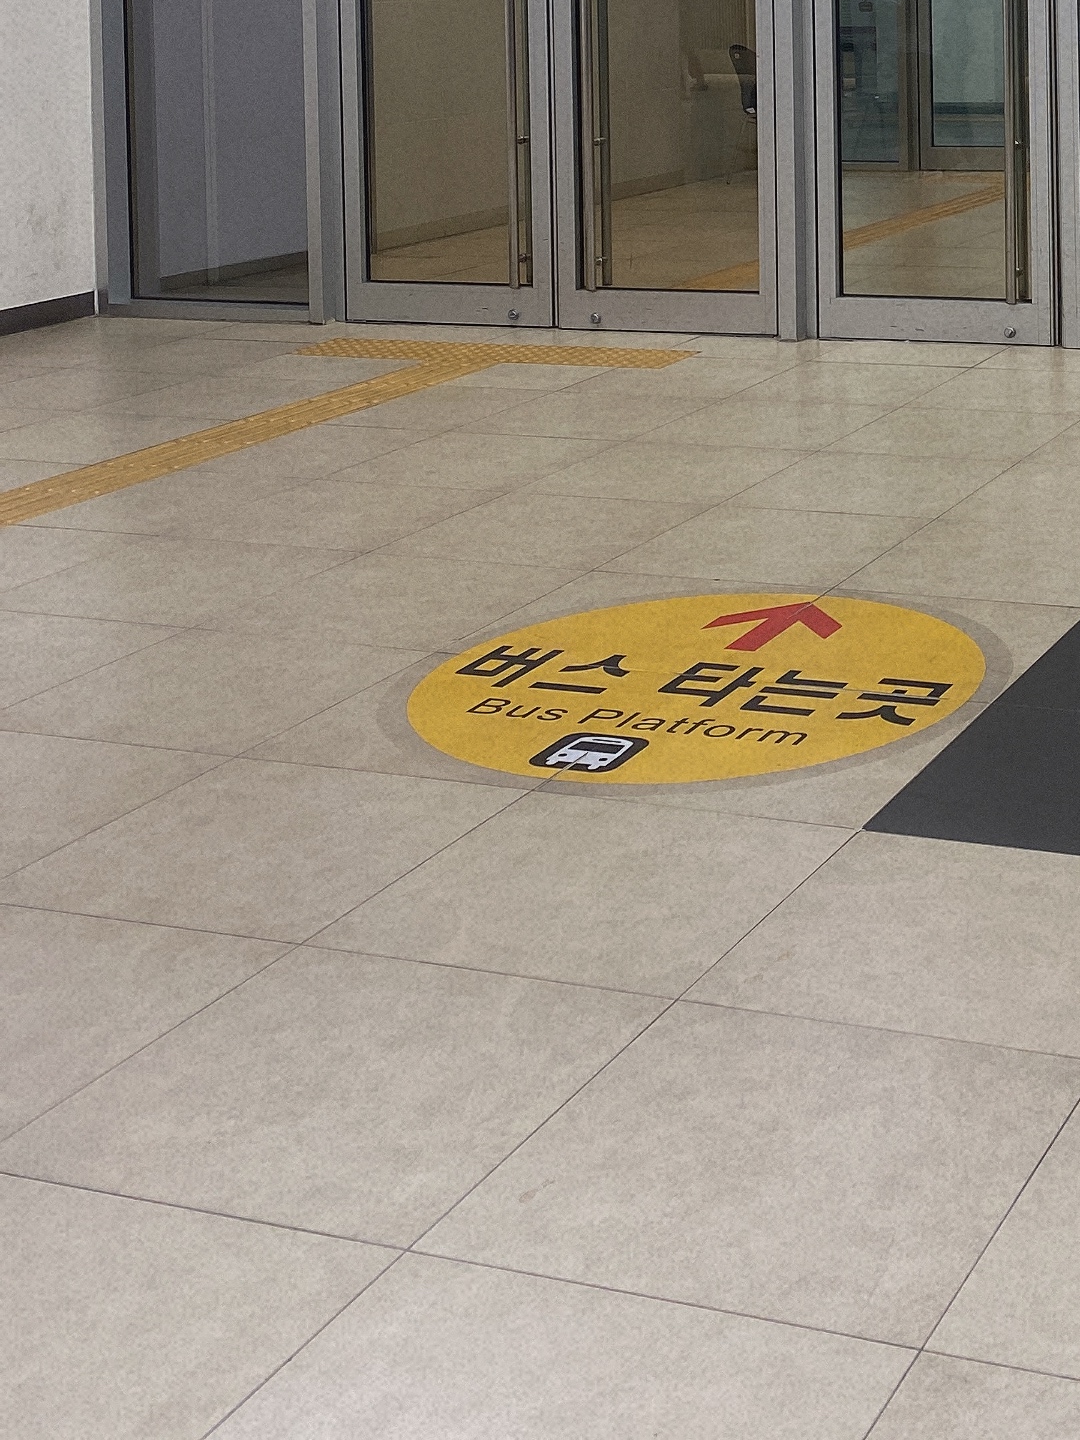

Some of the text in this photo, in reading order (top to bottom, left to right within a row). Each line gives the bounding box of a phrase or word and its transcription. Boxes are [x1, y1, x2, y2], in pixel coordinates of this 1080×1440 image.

[455, 644, 956, 726] 버스 타는곳
[465, 697, 809, 748] Bus Platform
